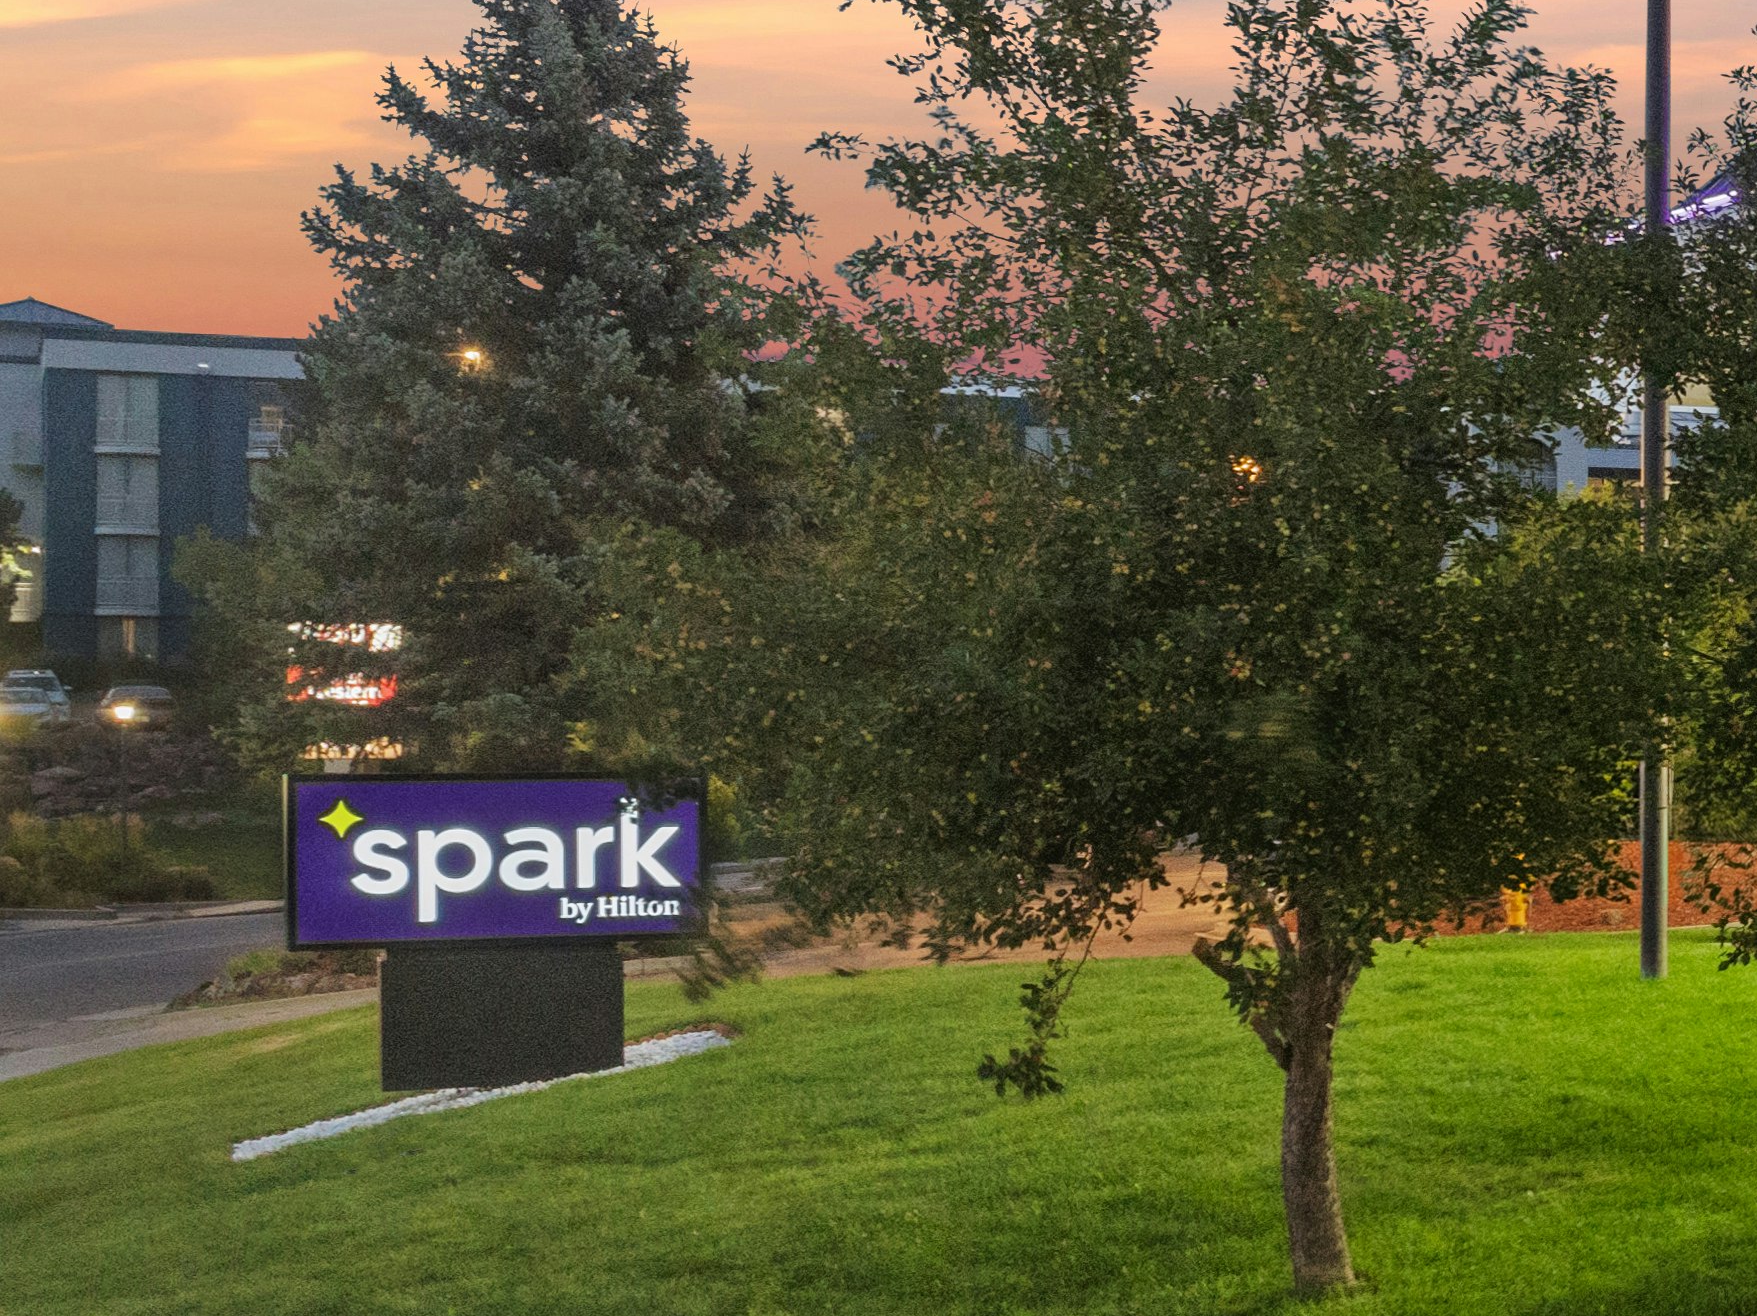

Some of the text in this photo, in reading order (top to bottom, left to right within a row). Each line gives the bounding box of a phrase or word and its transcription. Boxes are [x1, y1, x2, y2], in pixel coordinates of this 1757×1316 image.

[350, 796, 682, 923] spark
[559, 895, 681, 924] by Hilton
